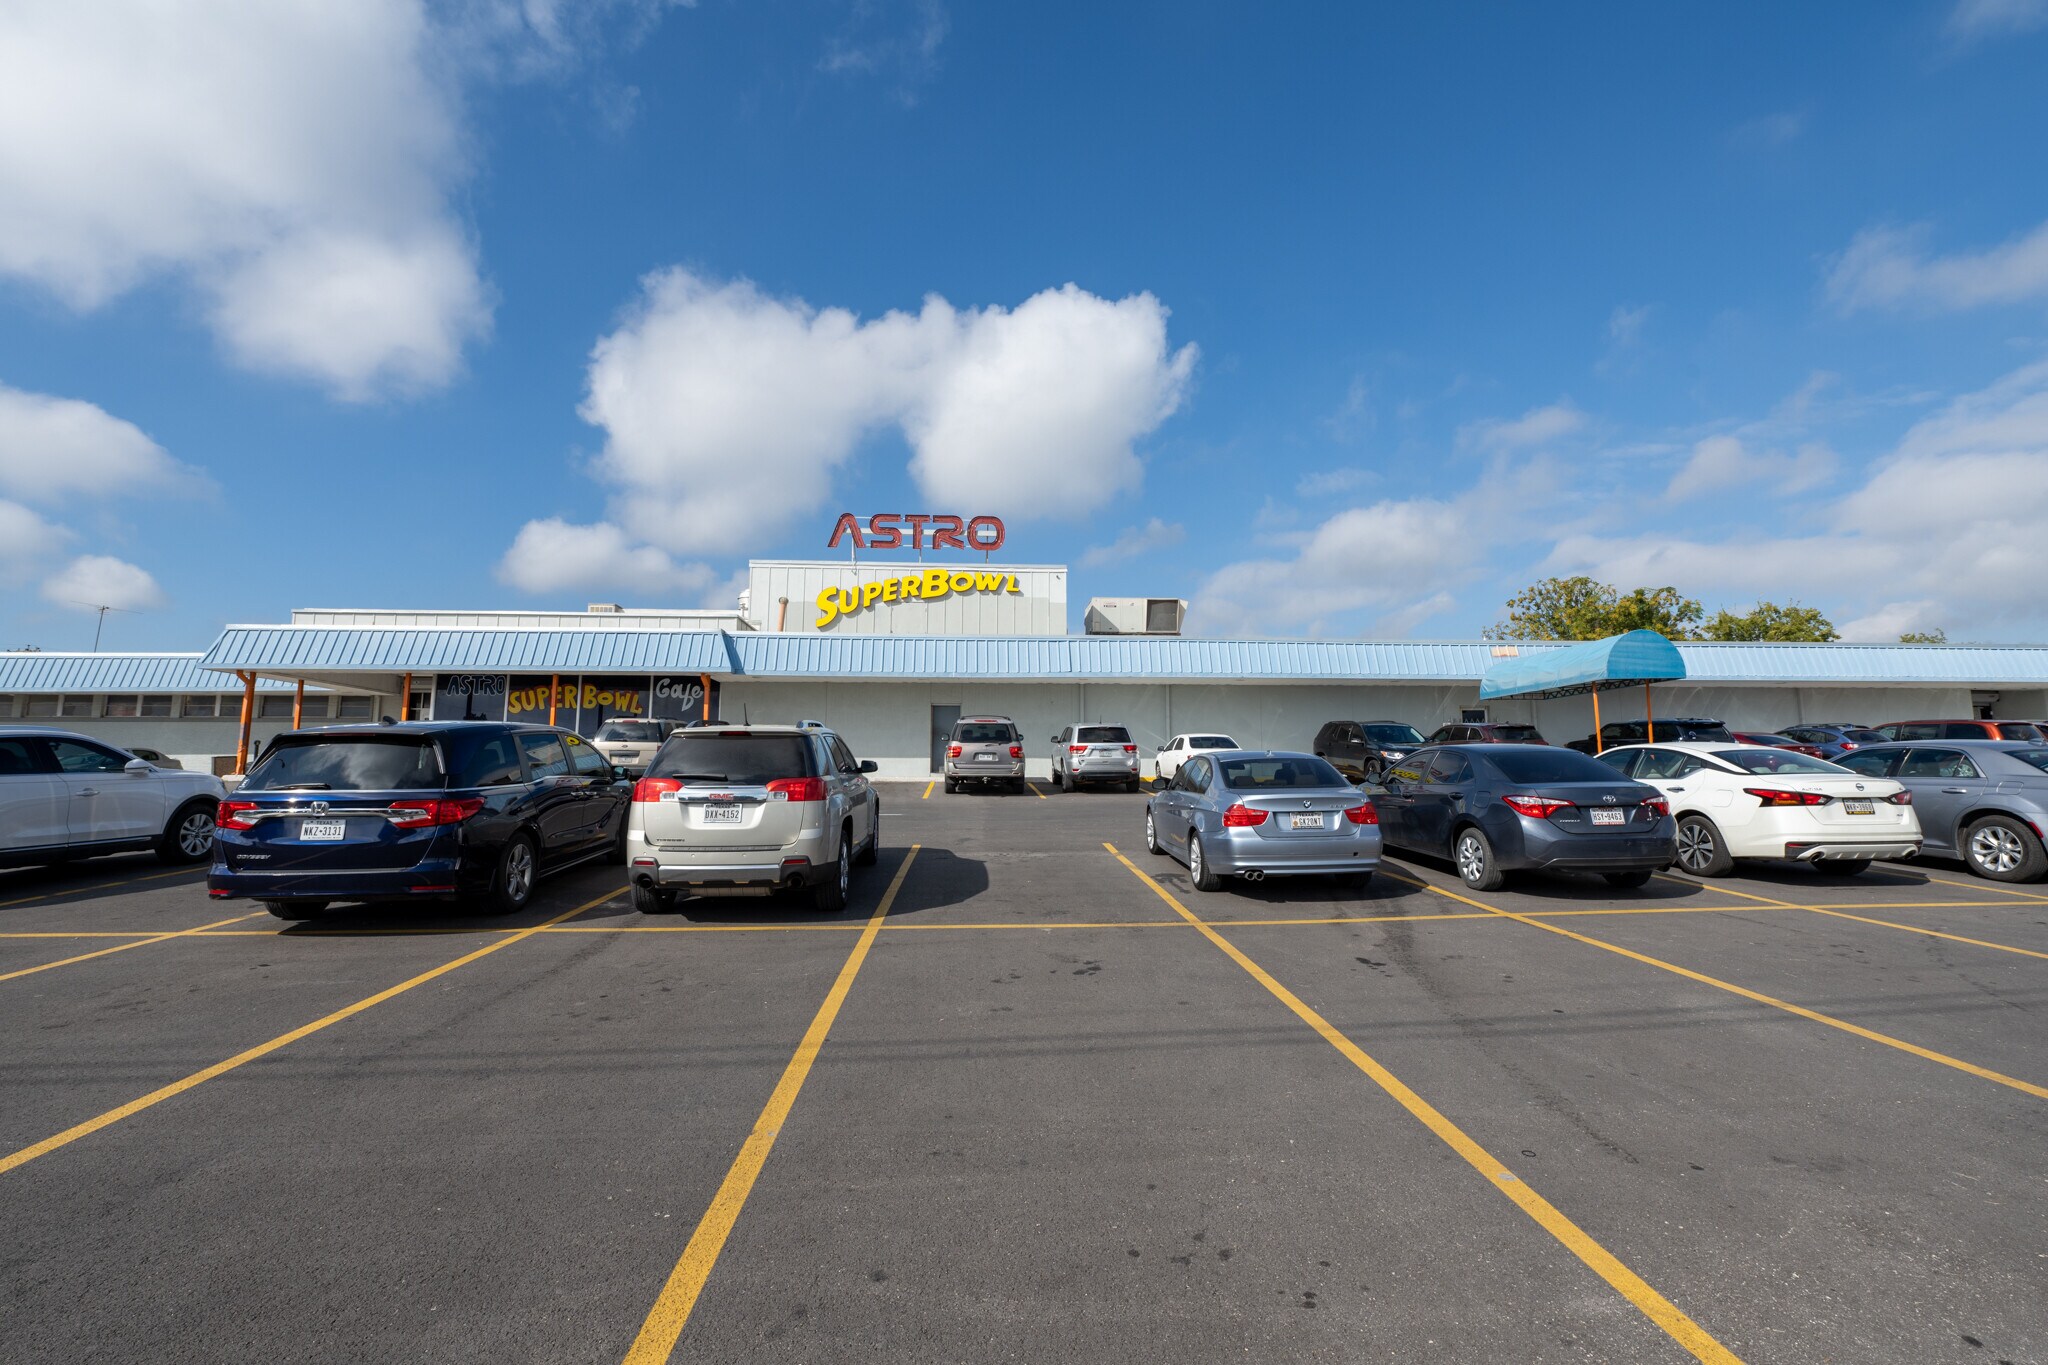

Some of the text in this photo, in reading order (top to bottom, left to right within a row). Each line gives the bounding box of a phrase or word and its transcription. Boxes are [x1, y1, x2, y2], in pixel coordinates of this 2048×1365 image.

[827, 512, 1006, 551] ASTRO
[446, 675, 506, 696] ASTRO
[656, 678, 704, 711] Cafe
